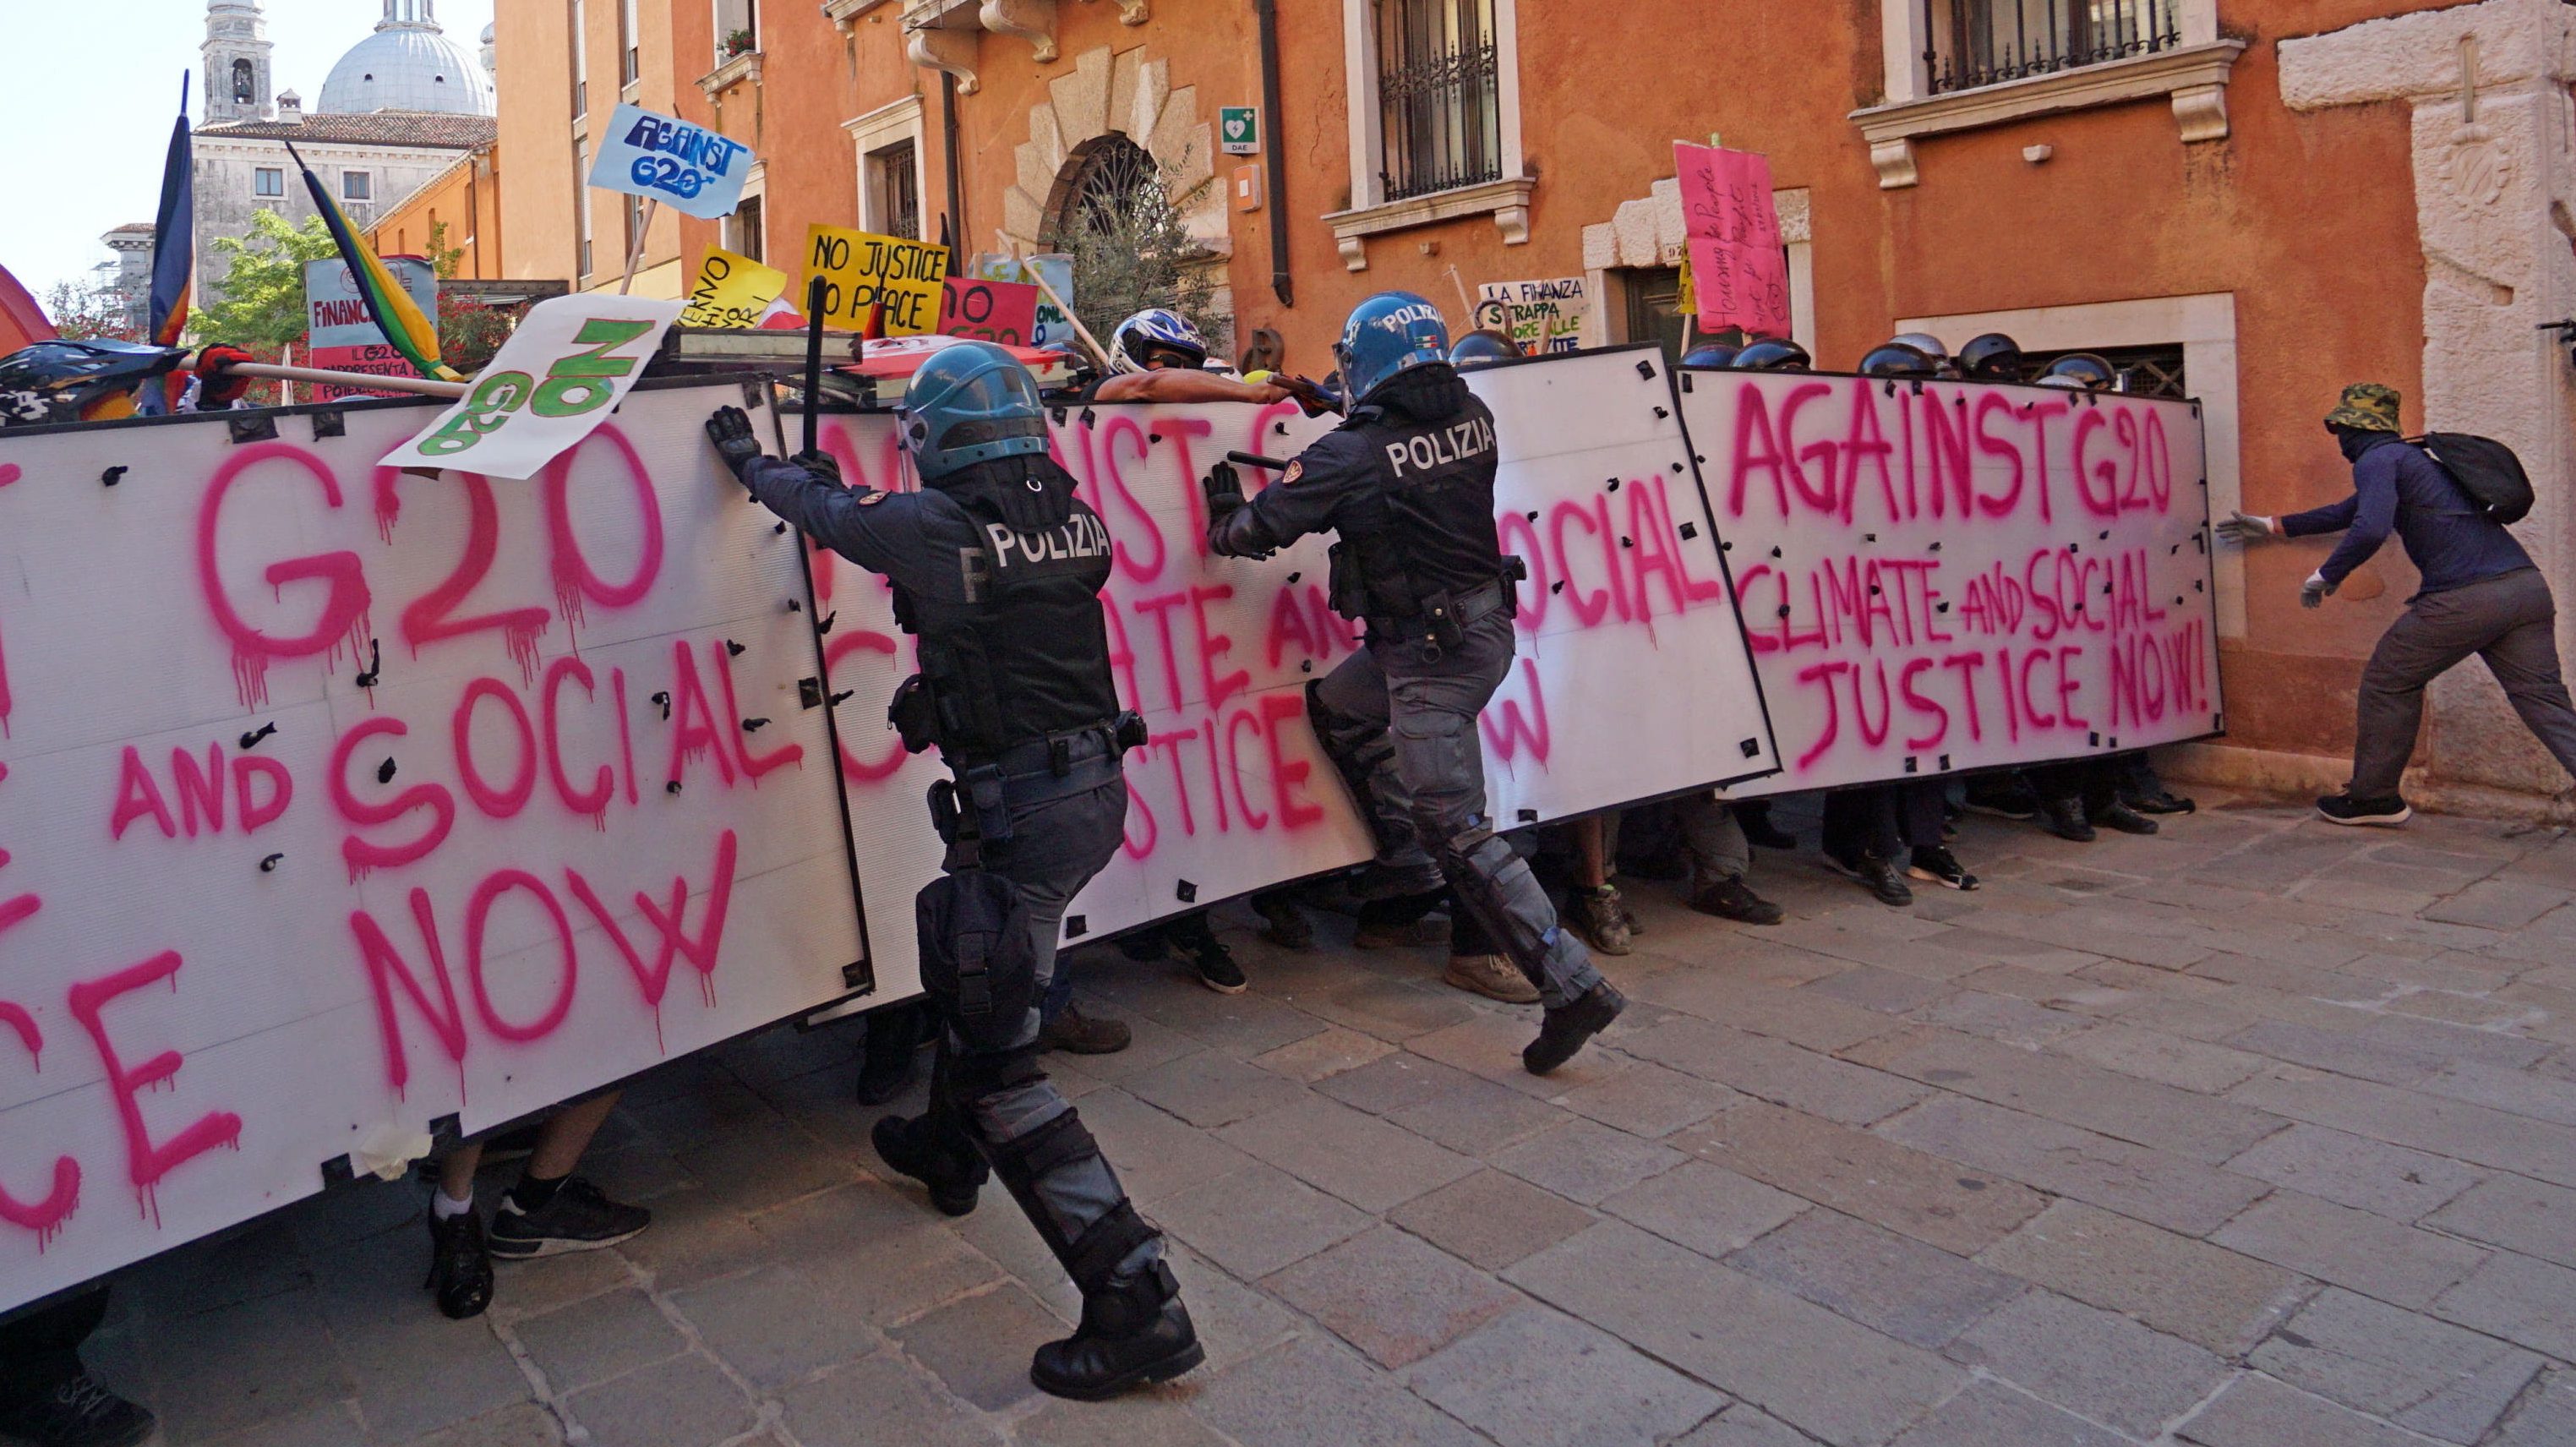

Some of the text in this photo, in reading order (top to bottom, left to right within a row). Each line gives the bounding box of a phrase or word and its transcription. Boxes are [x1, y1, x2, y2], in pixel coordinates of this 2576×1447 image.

[624, 115, 748, 177] AGAINST
[1695, 166, 1725, 219] People
[814, 235, 946, 283] NO JUSTICE
[1385, 417, 1496, 478] POLIZIA
[1728, 378, 2171, 525] AGAINST G20
[198, 423, 663, 661] G20
[986, 513, 1111, 567] POLIZIA
[1498, 473, 1721, 630] OCIAL
[1736, 549, 2166, 653] CLIMATE AND SOCIAL
[110, 740, 292, 842] AND
[330, 639, 805, 869] SOCIAL
[1798, 620, 2209, 771] JUSTICE NOW!
[349, 828, 737, 1089] NOW
